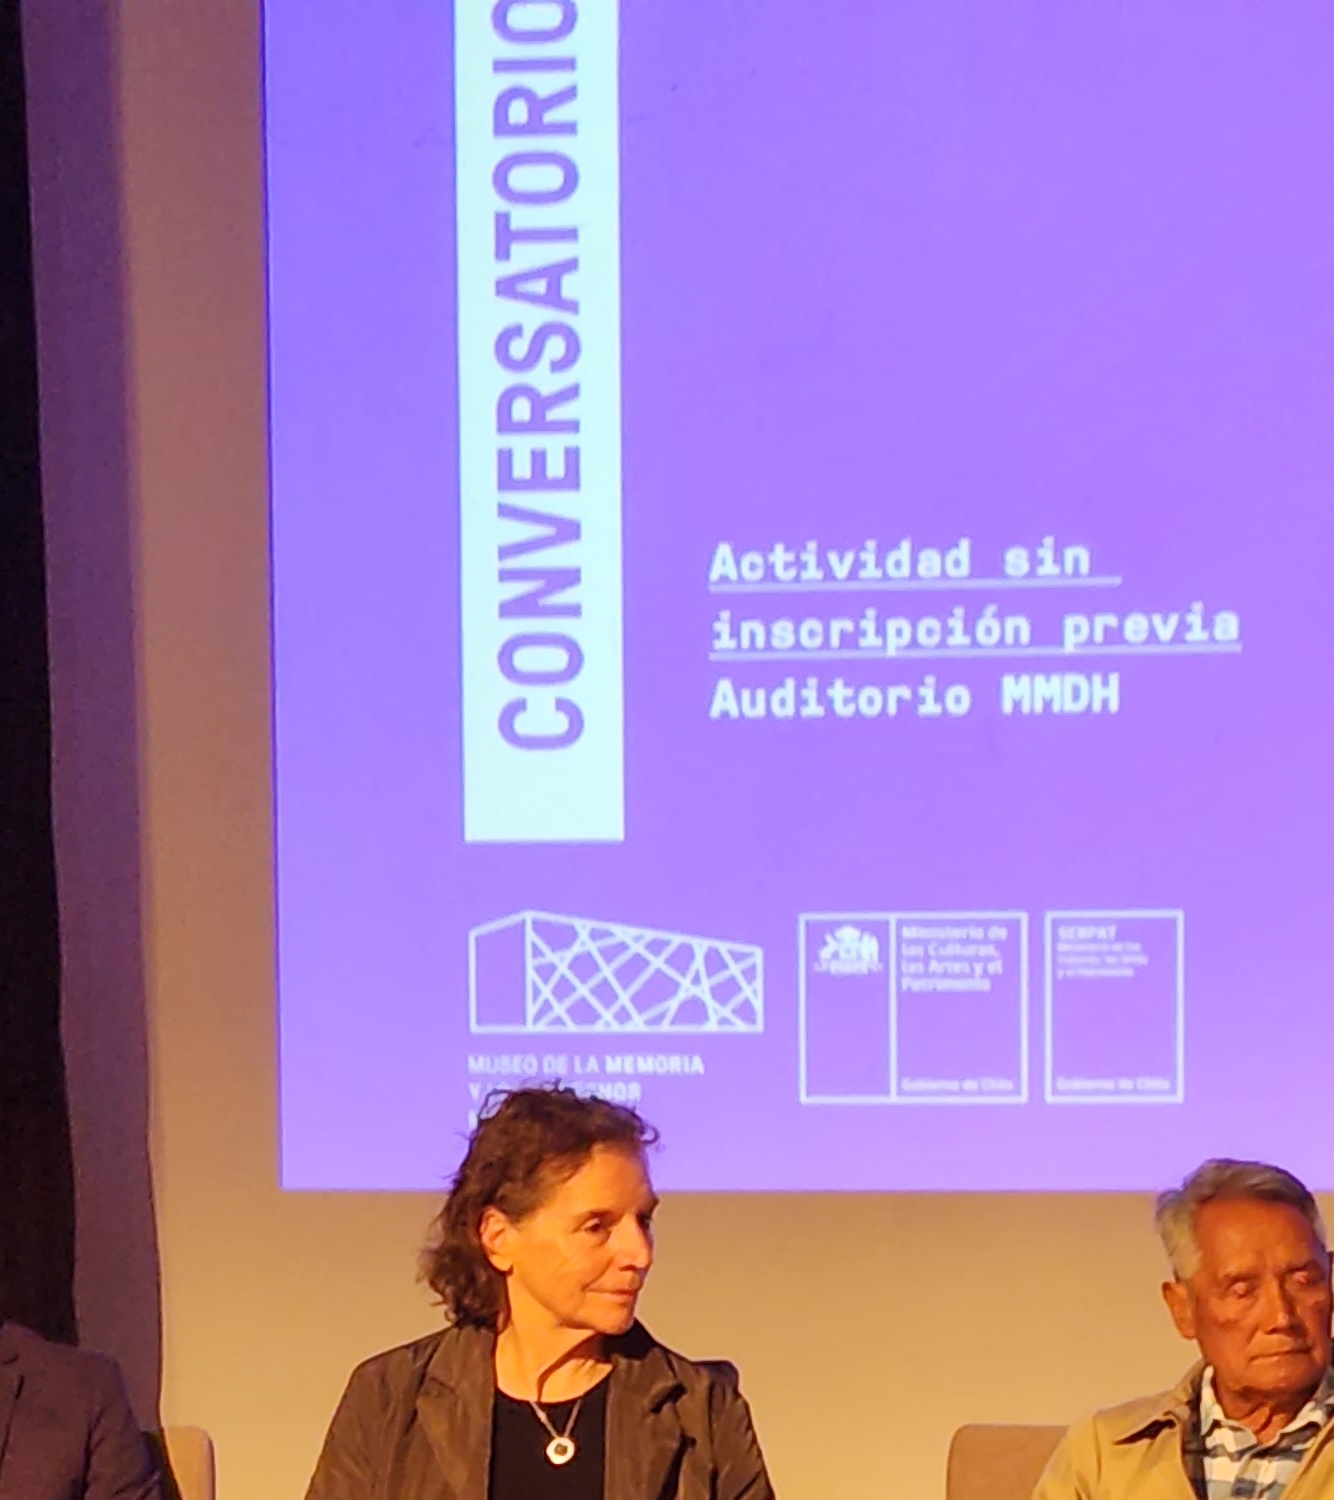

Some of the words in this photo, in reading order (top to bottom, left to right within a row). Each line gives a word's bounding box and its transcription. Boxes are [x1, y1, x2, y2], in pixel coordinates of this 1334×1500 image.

[491, 0, 585, 751] CONVERSATORIO
[709, 538, 971, 582] Actividad
[1004, 538, 1091, 577] sin
[711, 605, 1031, 655] inscripción
[1062, 601, 1241, 653] previa
[709, 675, 971, 719] Auditorio
[1002, 673, 1120, 714] MMDH
[468, 1054, 538, 1075] MUSEO
[542, 1054, 567, 1075] DE
[574, 1054, 599, 1075] LA
[605, 1054, 704, 1075] MEMORIA
